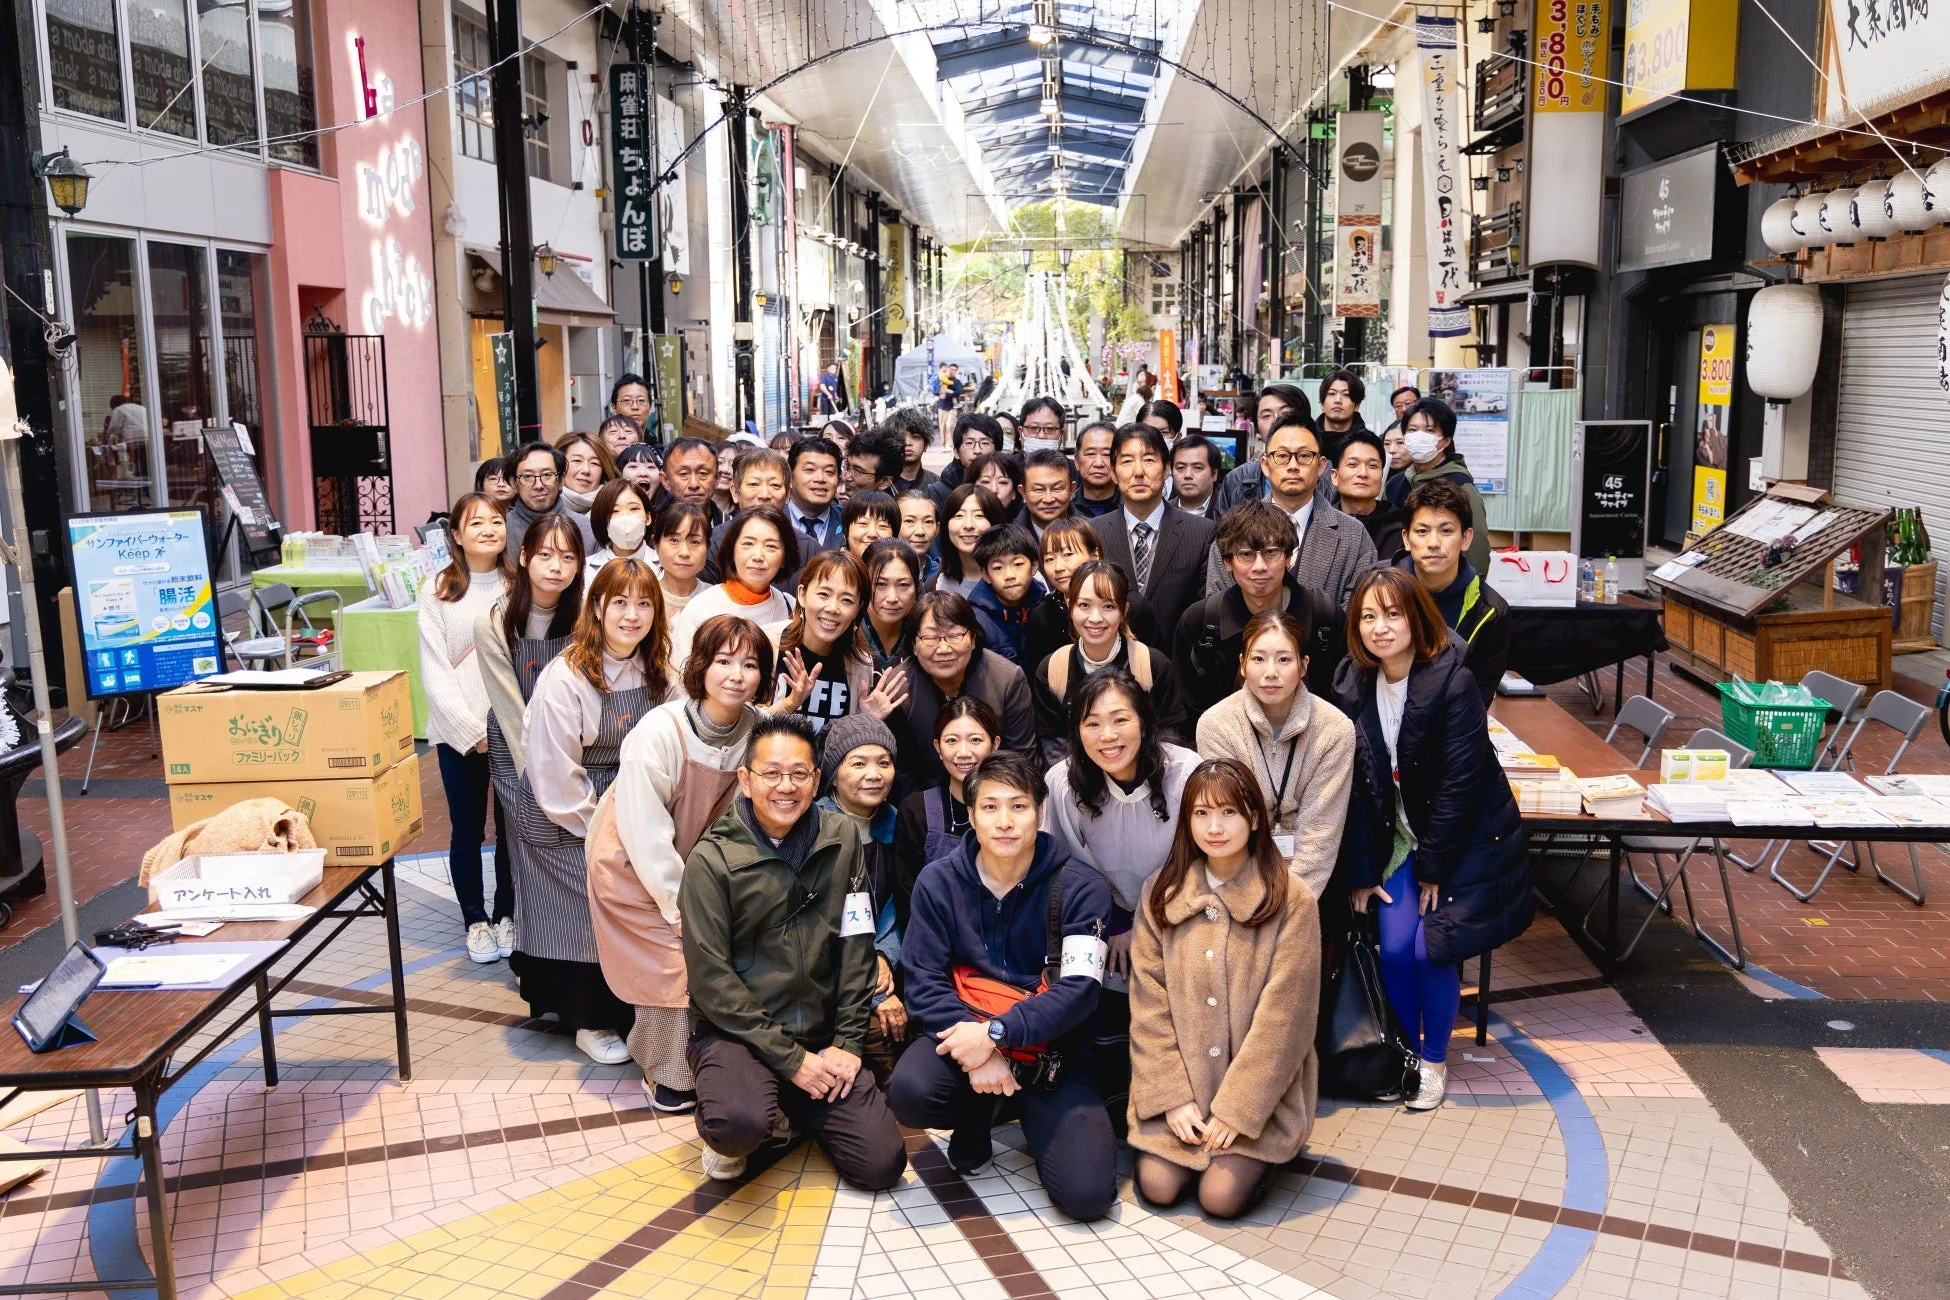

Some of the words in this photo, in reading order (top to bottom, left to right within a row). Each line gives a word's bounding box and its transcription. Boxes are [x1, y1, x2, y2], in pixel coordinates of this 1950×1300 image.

[1576, 4, 1587, 36] ほぐし
[1590, 4, 1601, 36] 手もみ
[619, 72, 640, 139] 麻雀荘
[364, 138, 423, 221] mode
[1659, 179, 1670, 200] 45
[619, 147, 647, 252] ちょんぼ
[1354, 203, 1366, 212] 2F
[371, 241, 433, 334] chick
[1605, 476, 1623, 489] 45
[1594, 491, 1634, 500] フォーティー
[1600, 499, 1628, 509] ファイブ
[86, 533, 189, 550] サンファイバーウォーター
[118, 549, 150, 560] Keep
[159, 586, 196, 606] 腸活
[184, 705, 204, 713] マスヤ
[229, 714, 282, 747] おにぎり
[236, 751, 300, 764] ファミリーパック
[171, 765, 190, 774] 14入
[173, 886, 272, 902] アンケート入れ
